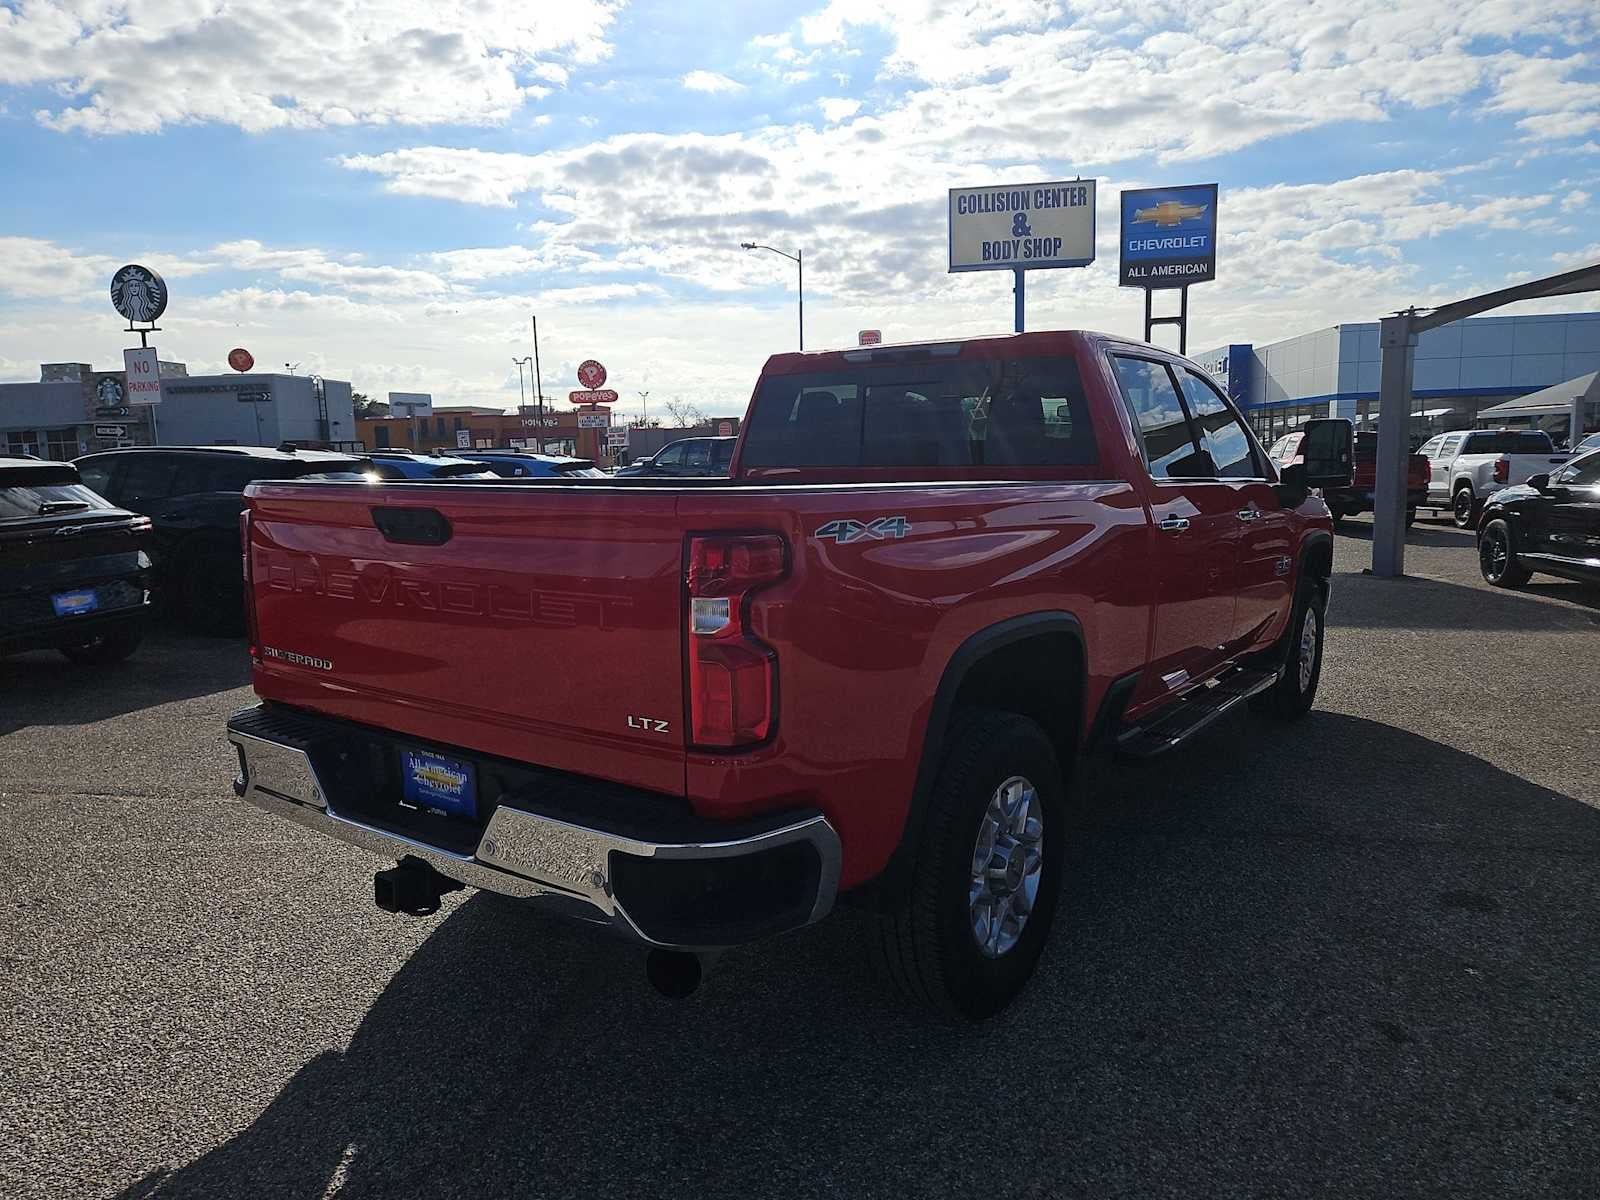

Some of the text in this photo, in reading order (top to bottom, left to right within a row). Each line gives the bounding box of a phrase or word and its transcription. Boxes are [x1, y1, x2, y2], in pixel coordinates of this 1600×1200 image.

[958, 186, 1087, 215] COLLISION CENTER
[1011, 212, 1032, 238] &
[982, 237, 1062, 261] BODY SHOP
[1129, 235, 1207, 252] CHEVROLET
[1127, 263, 1208, 279] ALL AMERICAN
[133, 360, 150, 373] NO
[128, 381, 159, 393] PARKING
[815, 515, 913, 545] 4X4
[266, 562, 634, 632] CHEVROLET
[263, 645, 333, 672] SILVERADO
[627, 714, 670, 734] LTZ
